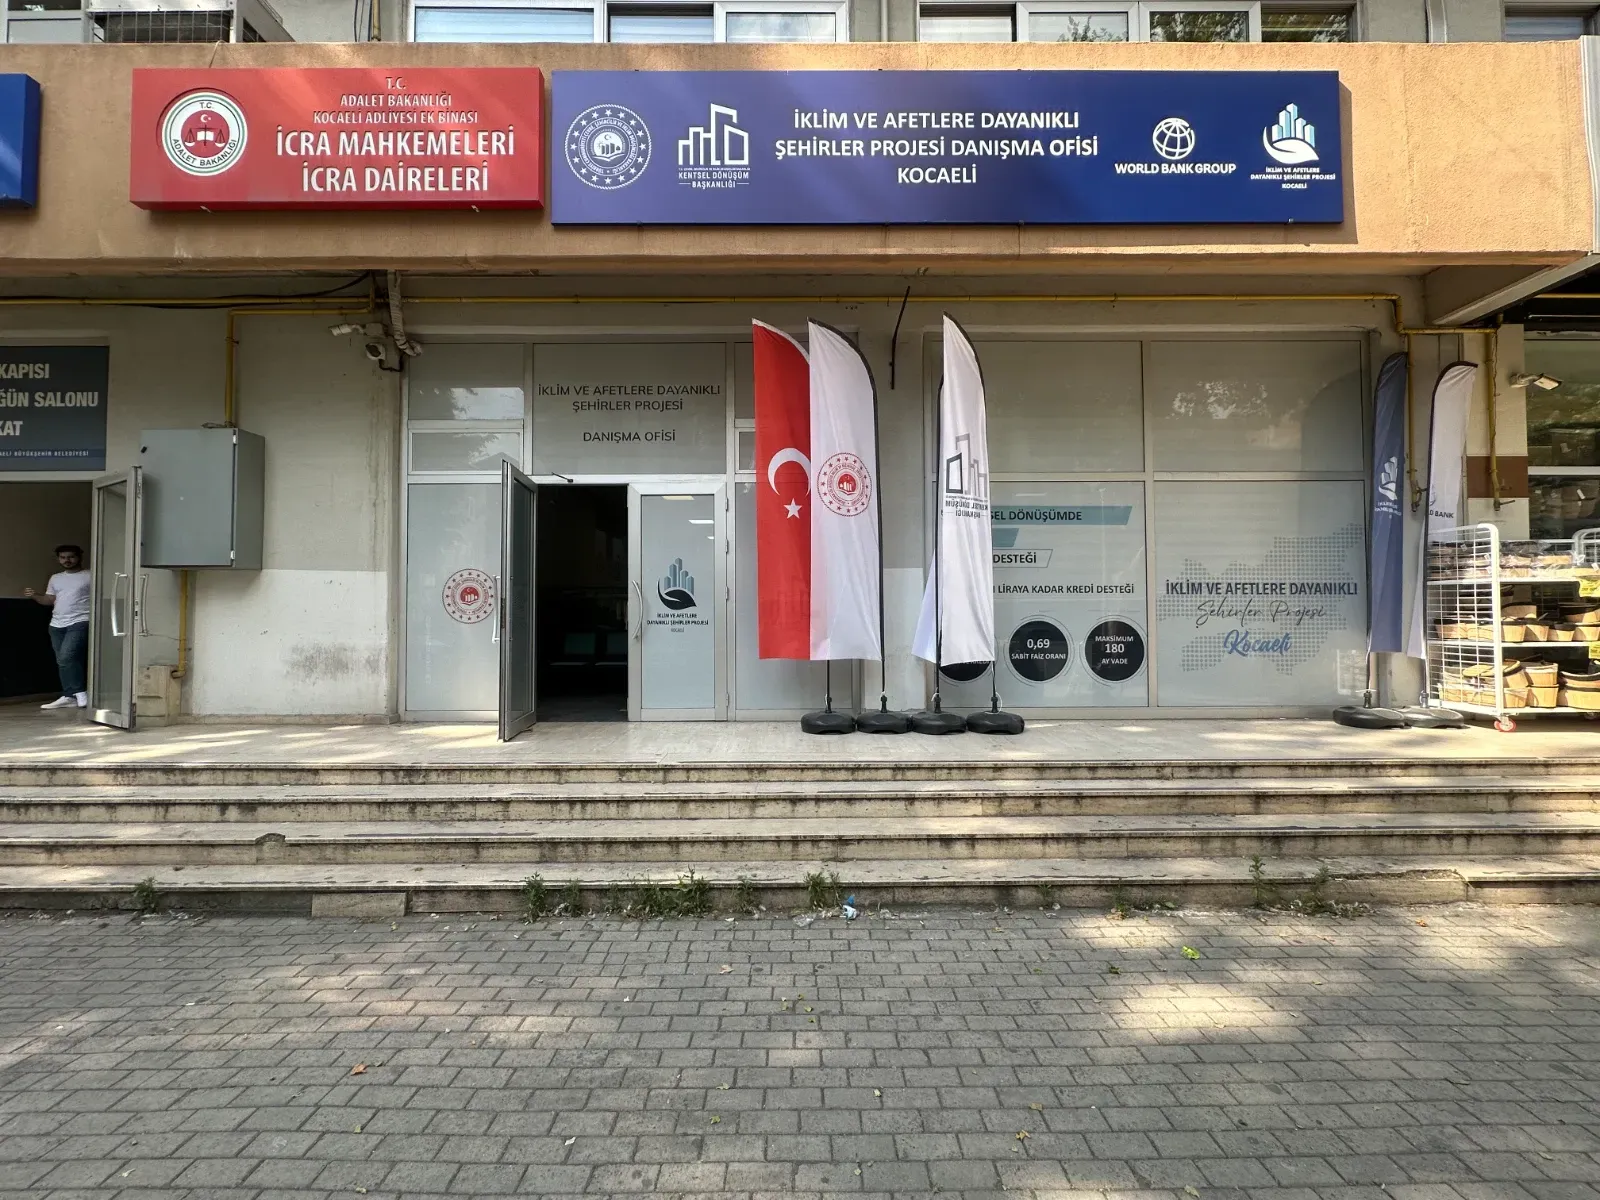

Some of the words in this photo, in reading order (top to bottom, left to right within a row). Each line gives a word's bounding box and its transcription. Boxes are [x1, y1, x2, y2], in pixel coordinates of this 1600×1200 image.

[385, 76, 407, 90] T.C.
[340, 94, 384, 108] ADALET
[387, 91, 452, 107] BAKANLIĞI
[313, 108, 362, 124] KOCAELİ
[364, 107, 418, 124] ADLİYESİ
[420, 110, 436, 124] EK
[438, 107, 478, 124] BİNASI
[794, 109, 848, 129] İKLİM
[853, 112, 878, 129] VE
[883, 112, 975, 129] AFETLERE
[981, 111, 1079, 129] DAYANIKLI
[276, 127, 332, 156] İCRA
[338, 126, 515, 156] MAHKEMELERİ
[775, 136, 865, 160] ŞEHİRLER
[870, 136, 945, 160] PROJESİ
[951, 139, 1045, 160] DANIŞMA
[1049, 135, 1098, 156] OFİSİ
[172, 138, 197, 165] ADALET
[897, 163, 977, 184] KOCAELİ
[1114, 163, 1160, 174] WORLD
[1161, 163, 1194, 174] BANK
[1195, 163, 1237, 174] GROUP
[302, 161, 357, 192] İCRA
[365, 161, 489, 192] DAİRELERİ
[678, 172, 711, 180] KENTSEL
[713, 171, 749, 181] DÖNÜŞÜM
[691, 180, 736, 190] BAŞKANLIĞI
[538, 384, 570, 396] İKLİM
[573, 385, 590, 396] VE
[593, 385, 654, 396] AFETLERE
[657, 384, 721, 396] DAYANIKLI
[34, 391, 98, 408] SALONU
[572, 398, 631, 413] ŞEHİRLER
[634, 398, 683, 413] PROJESİ
[583, 431, 641, 444] DANIŞMA
[644, 429, 676, 442] OFİSİ
[1009, 509, 1082, 523] DÖNÜŞÜMDE
[1435, 510, 1454, 519] BANK
[993, 551, 1037, 564] DESTEĞİ
[998, 583, 1029, 594] LİRAYA
[1031, 584, 1063, 594] KADAR
[1066, 583, 1094, 594] KREDİ
[1096, 583, 1134, 594] DESTEĞİ
[1166, 579, 1203, 595] İKLİM
[1206, 582, 1222, 595] VE
[1225, 582, 1286, 595] AFETLERE
[1289, 582, 1358, 596] DAYANIKLI
[1026, 638, 1050, 651] 0,69
[1094, 634, 1134, 642] MAKSİMUM
[1223, 629, 1293, 657] Kocaeli
[1105, 643, 1125, 654] 180
[1011, 652, 1030, 660] SABİT
[1030, 652, 1044, 660] FAİZ
[1045, 652, 1066, 660] ORANI
